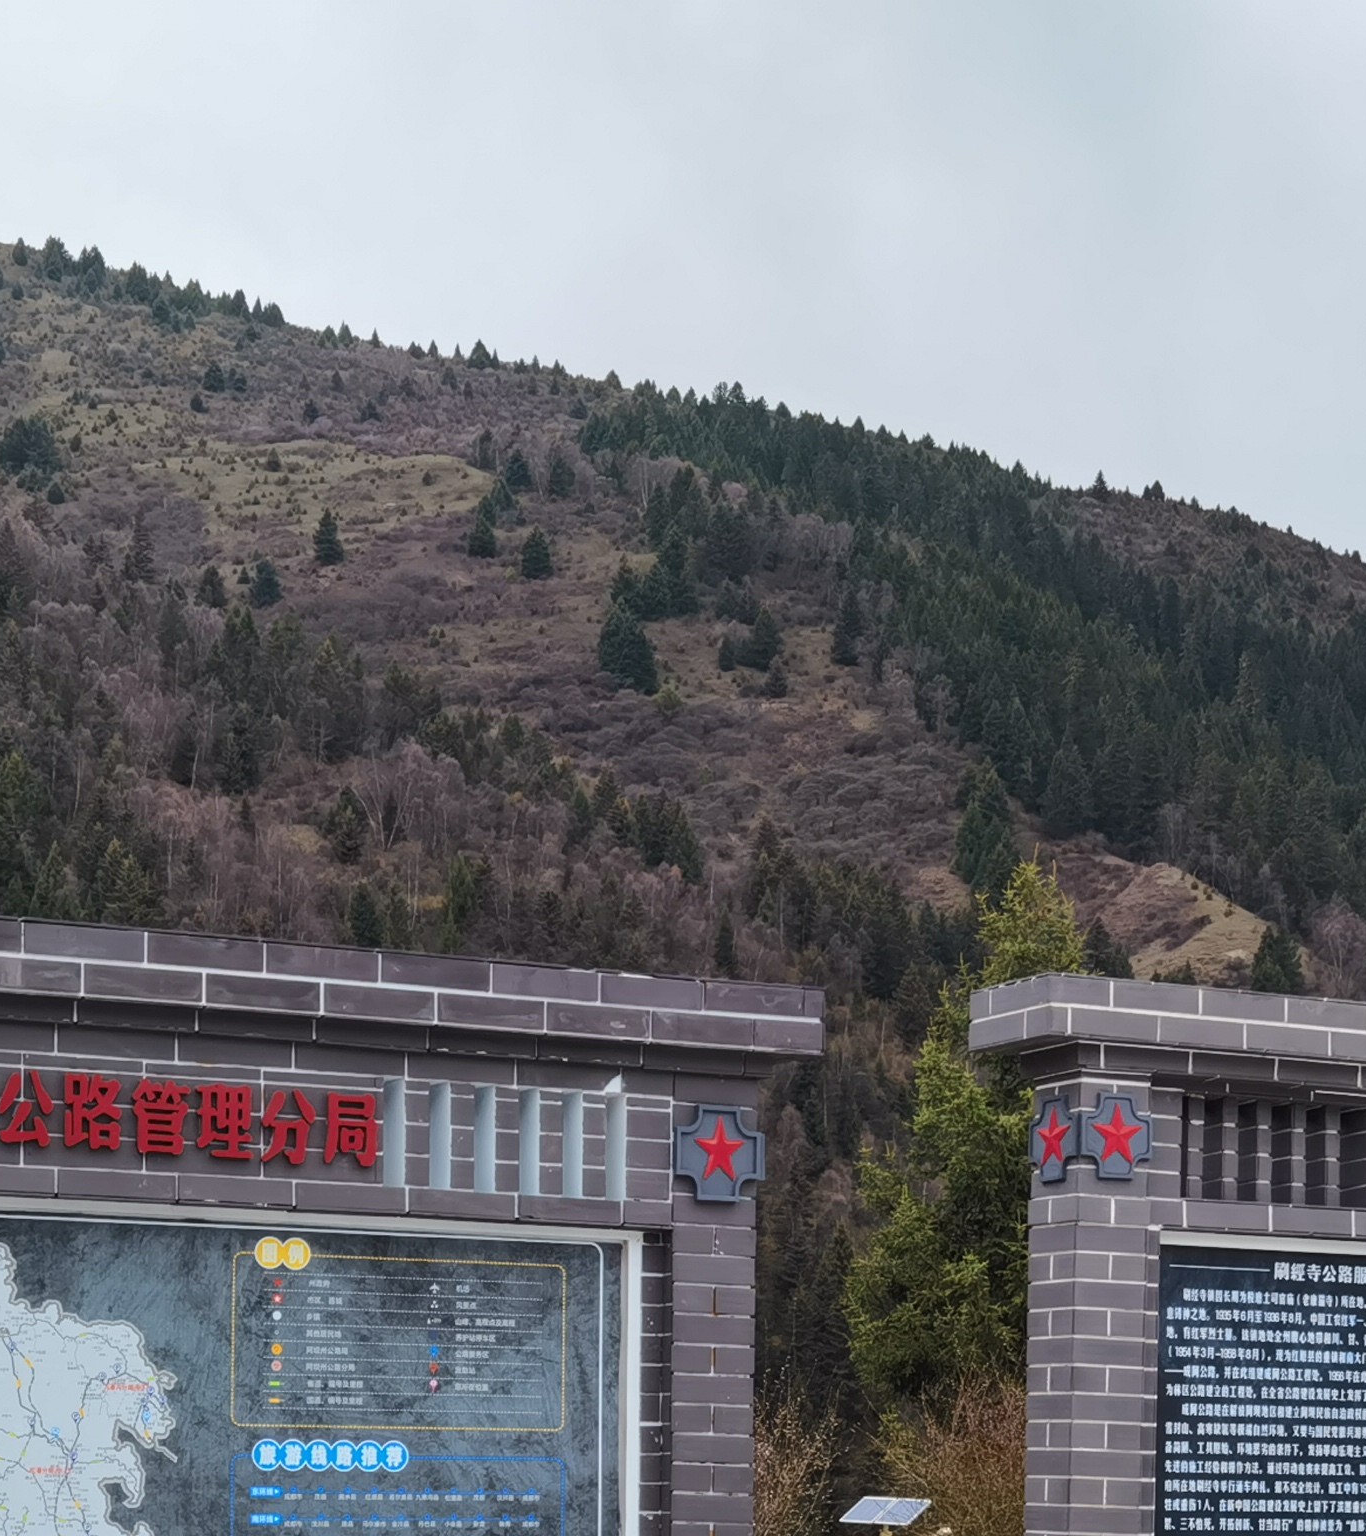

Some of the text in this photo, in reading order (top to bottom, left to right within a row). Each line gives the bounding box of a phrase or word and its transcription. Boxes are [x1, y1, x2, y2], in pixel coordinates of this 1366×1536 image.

[257, 1443, 405, 1469] 旅游线路推荐
